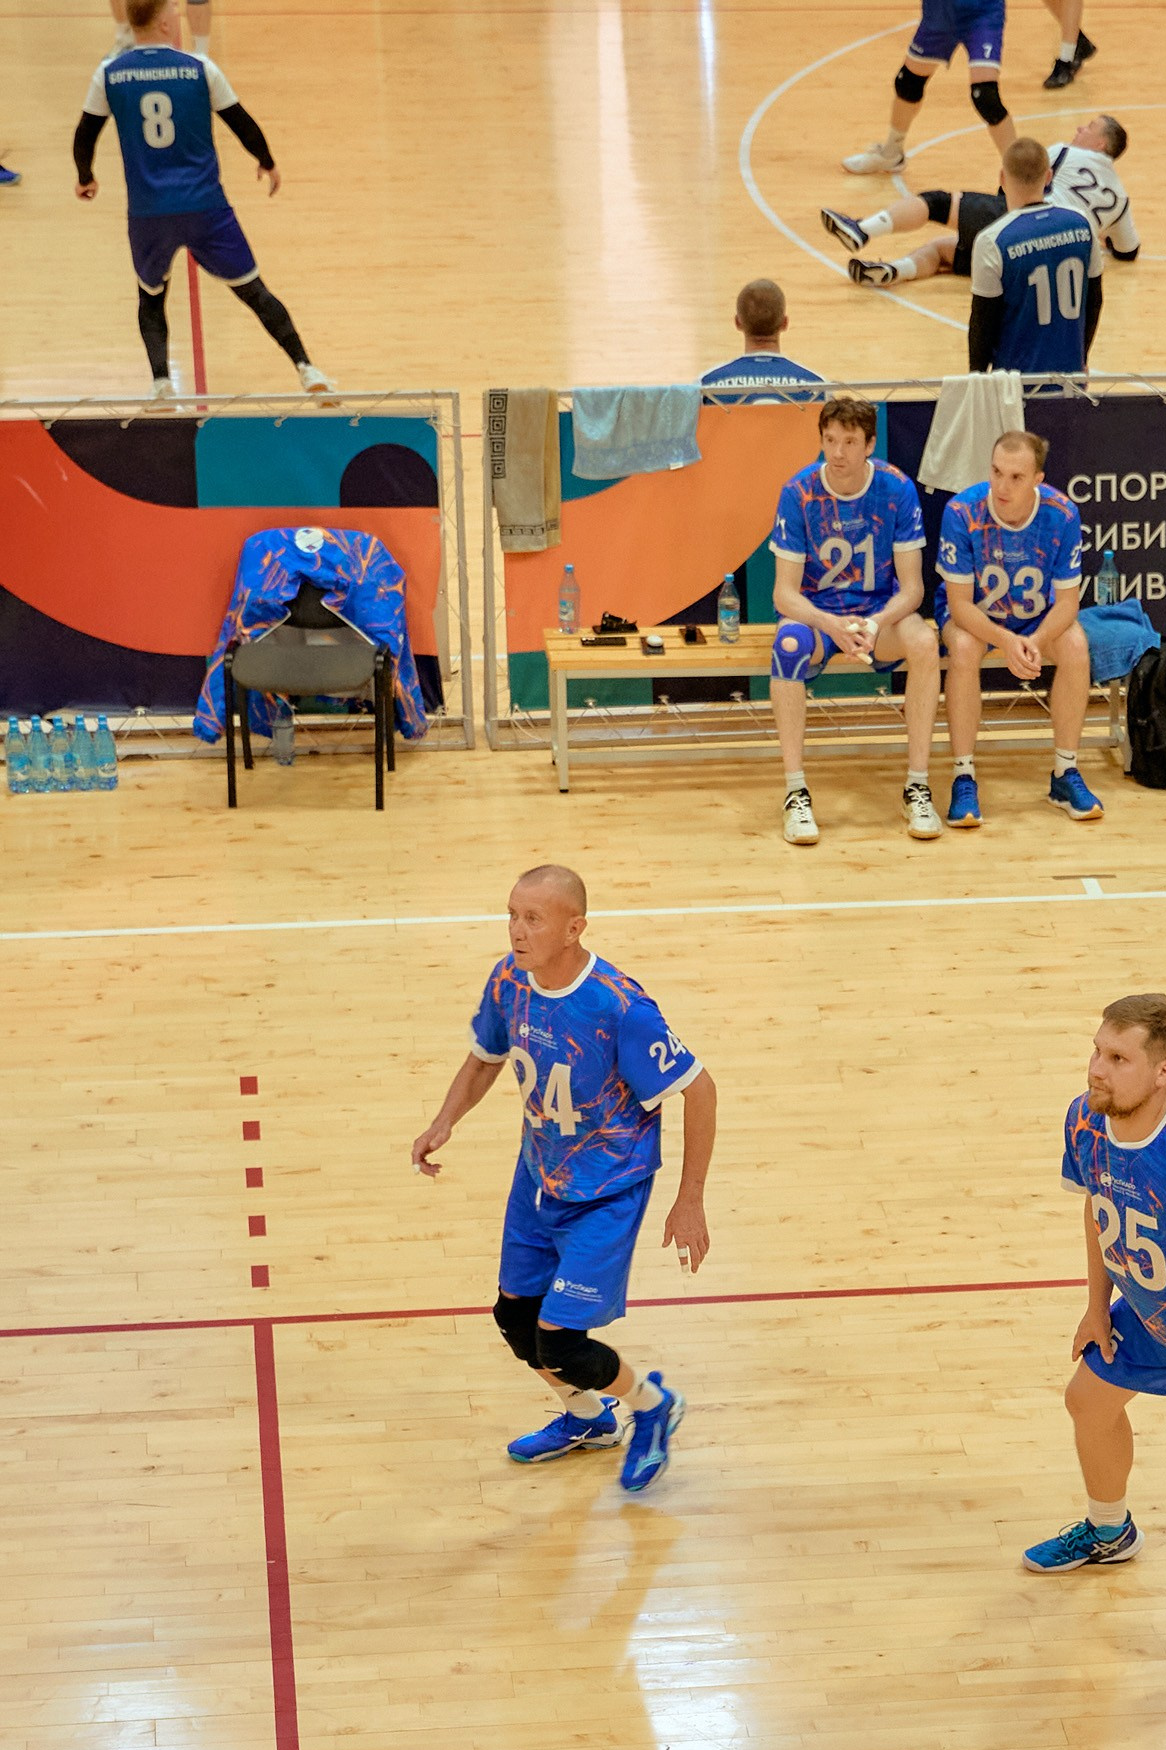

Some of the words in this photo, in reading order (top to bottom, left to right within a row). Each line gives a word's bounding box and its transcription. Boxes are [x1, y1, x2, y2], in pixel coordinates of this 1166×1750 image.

[108, 67, 178, 84] БОГУЧАНСКАЯ
[140, 91, 175, 149] 8
[1068, 167, 1119, 225] 22
[1007, 229, 1075, 260] БОГУЧАНСКАЯ
[1027, 256, 1085, 326] 10
[711, 376, 798, 388] ГУЧАНСКАЯ
[818, 533, 876, 591] 21
[975, 564, 1046, 620] 23
[649, 1029, 687, 1074] 24
[508, 1046, 582, 1136] 24
